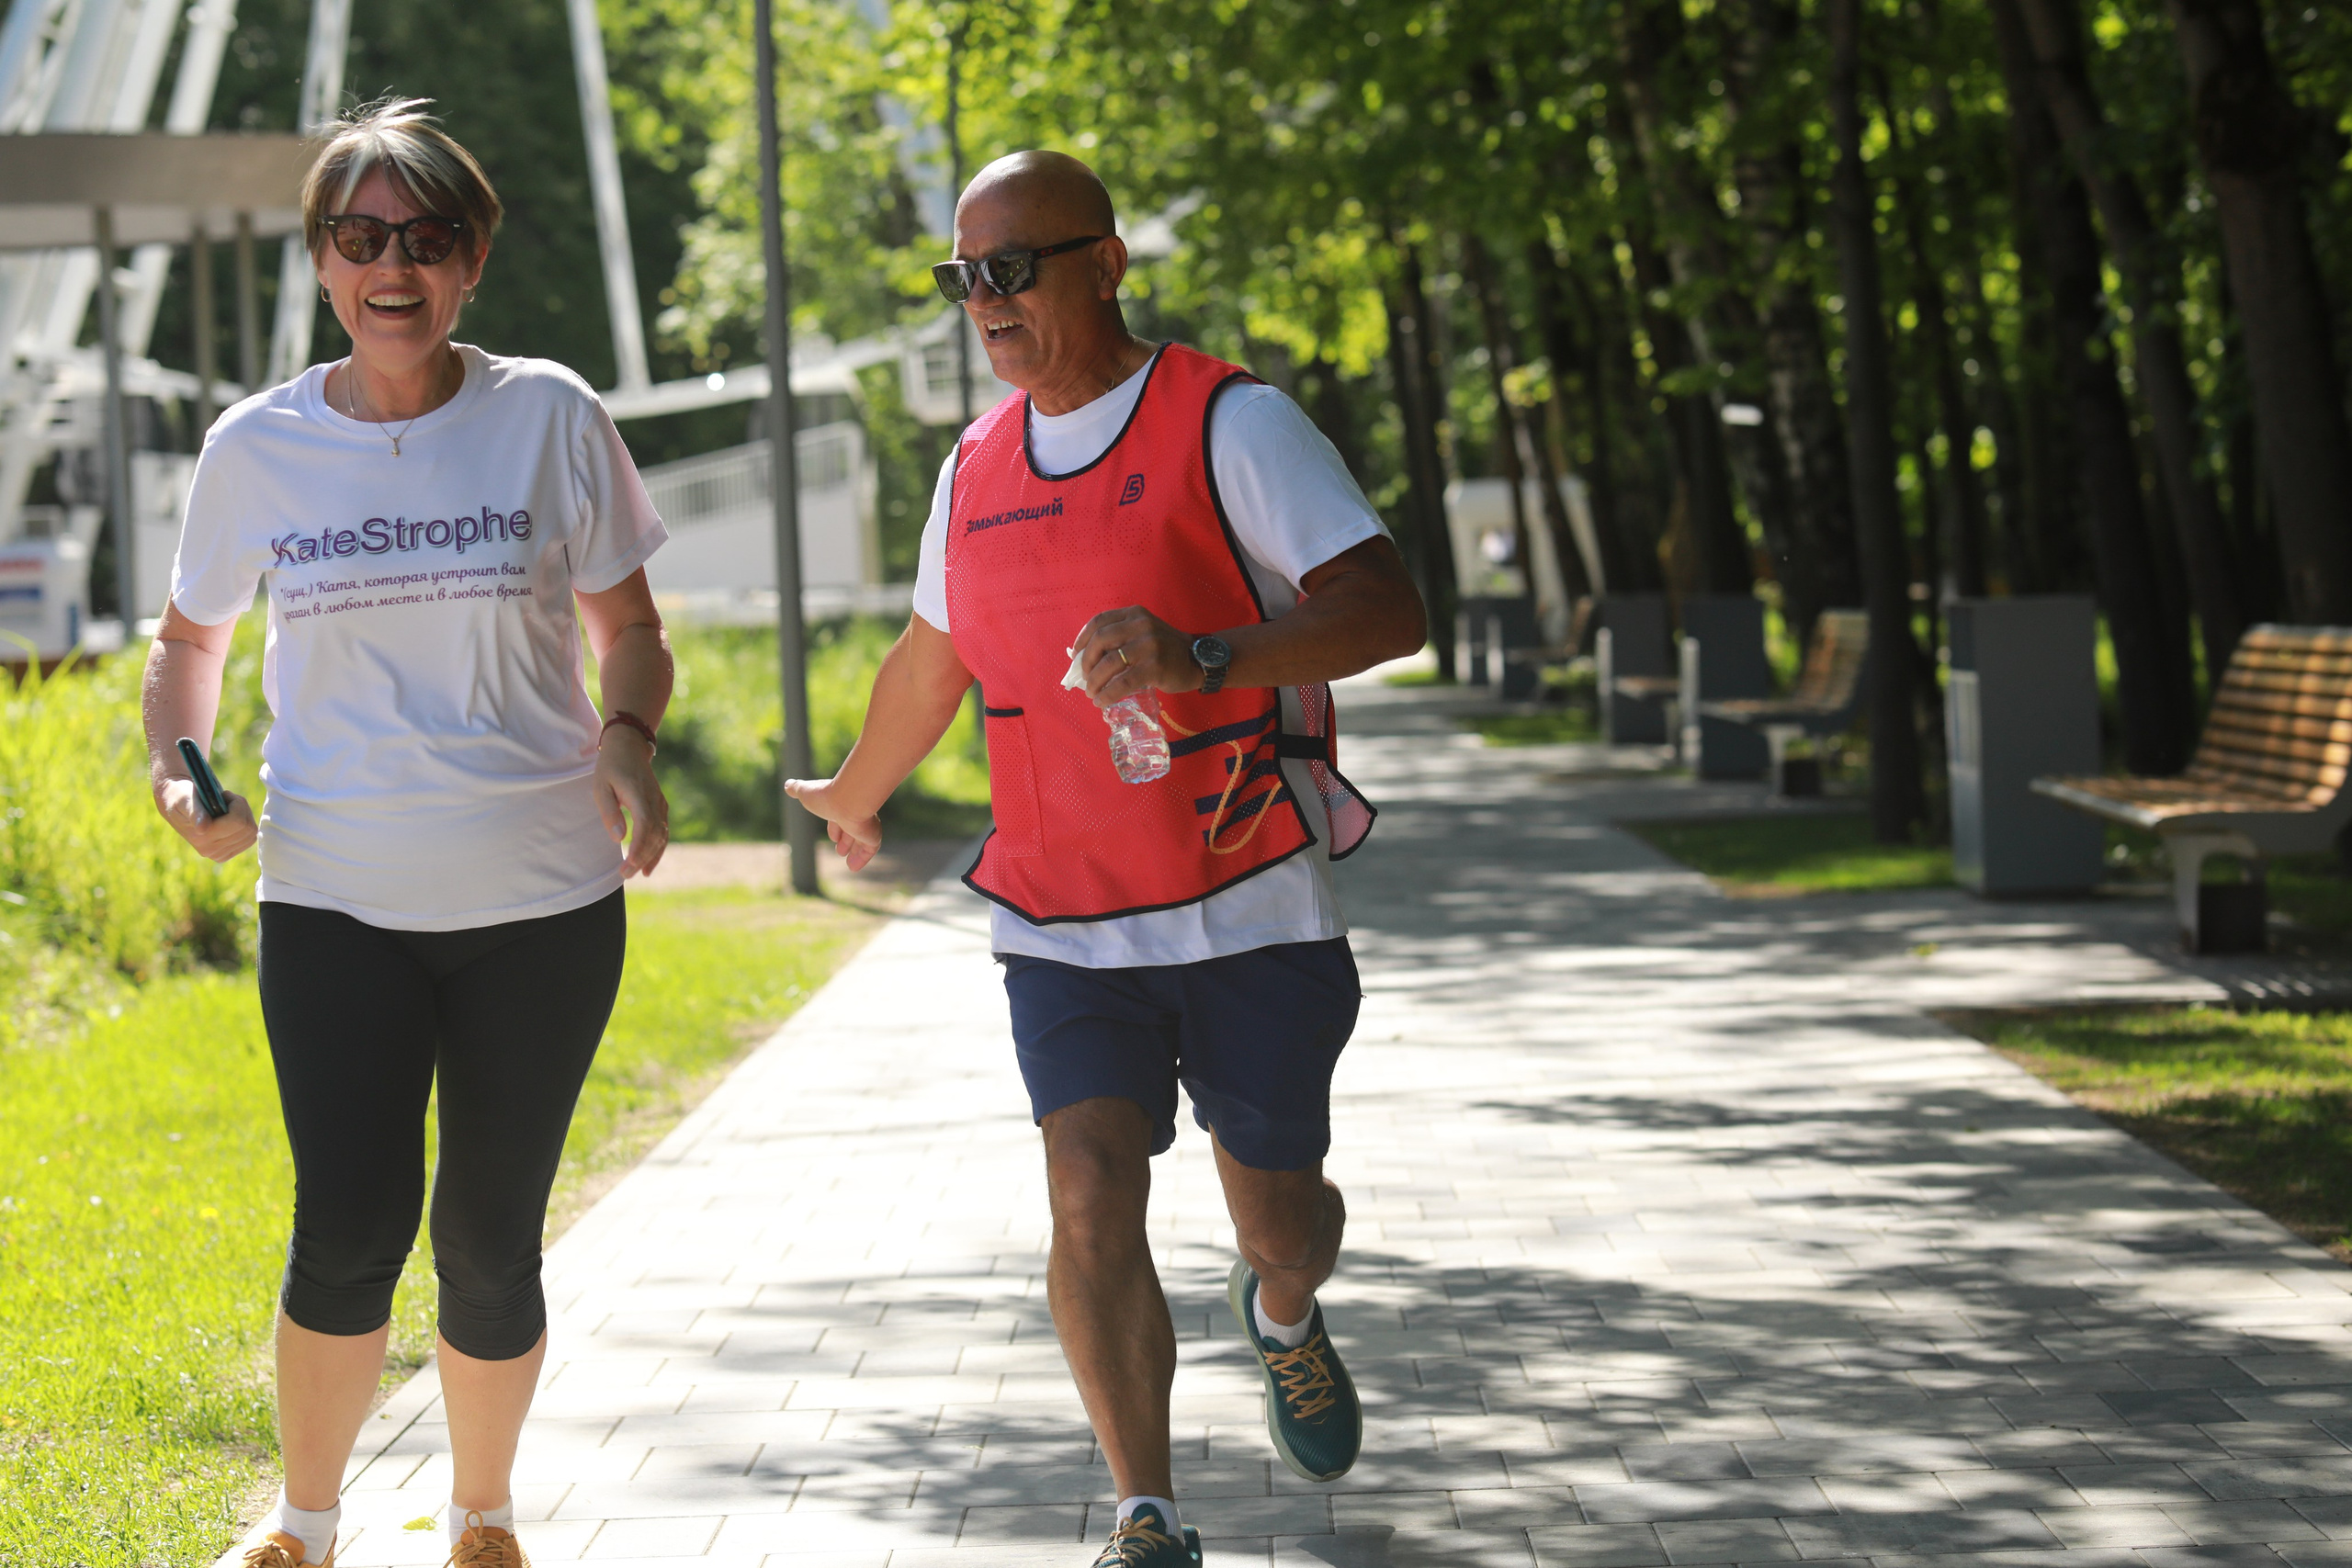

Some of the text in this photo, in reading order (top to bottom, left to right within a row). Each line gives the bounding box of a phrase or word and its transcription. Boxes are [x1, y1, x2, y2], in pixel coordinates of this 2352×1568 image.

[271, 506, 532, 568] KateStrophe
[316, 581, 361, 593] Катя,
[365, 573, 427, 589] которая
[432, 567, 498, 586] устроит
[501, 562, 526, 575] вам
[313, 603, 321, 615] в
[324, 597, 374, 614] любом
[377, 594, 423, 606] месте
[425, 592, 435, 602] и
[437, 588, 447, 601] в
[449, 585, 494, 600] любое
[497, 583, 533, 602] время
